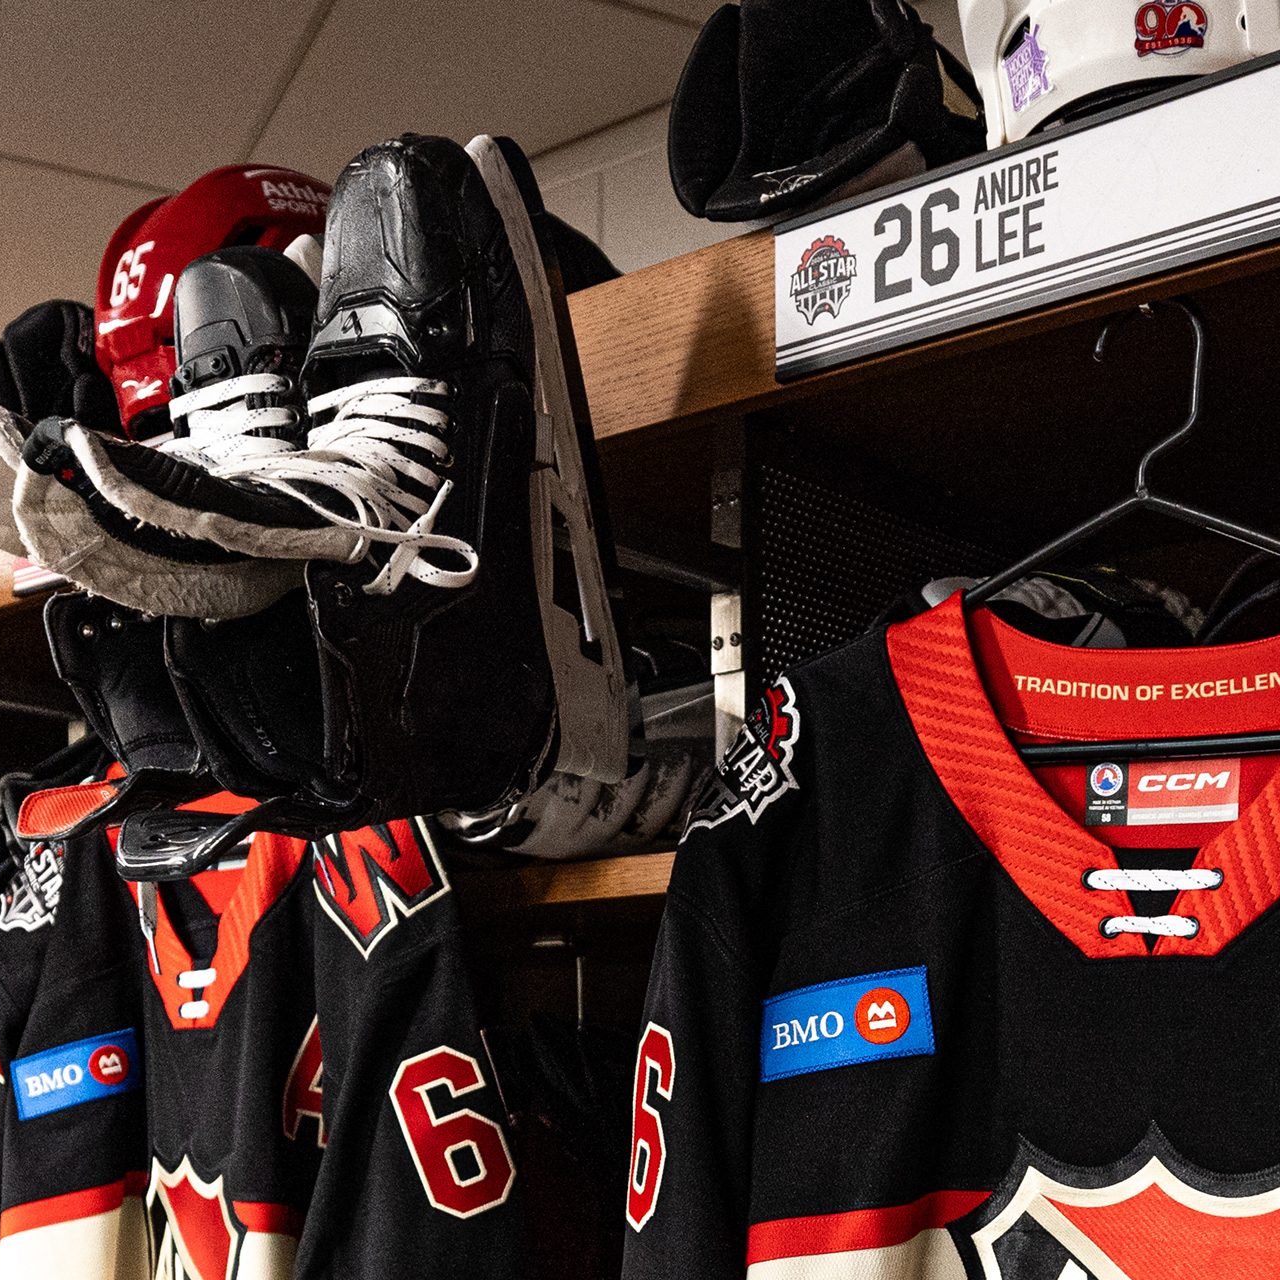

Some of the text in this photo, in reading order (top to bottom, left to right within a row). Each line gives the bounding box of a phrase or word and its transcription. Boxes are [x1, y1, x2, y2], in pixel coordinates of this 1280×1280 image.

[1169, 37, 1192, 45] 1936
[261, 180, 331, 206] Athle
[974, 152, 1059, 215] ANDRE
[874, 187, 961, 303] 26
[975, 198, 1046, 272] LEE
[109, 240, 155, 308] 65
[792, 256, 855, 294] ALL STAR
[1014, 675, 1129, 701] TRADITION
[1135, 685, 1164, 701] OF
[753, 722, 770, 744] AHL
[1137, 771, 1231, 792] CCM
[772, 1011, 844, 1051] BMO
[24, 1063, 83, 1097] BMO
[389, 1045, 515, 1218] 6
[626, 1021, 675, 1233] 6
